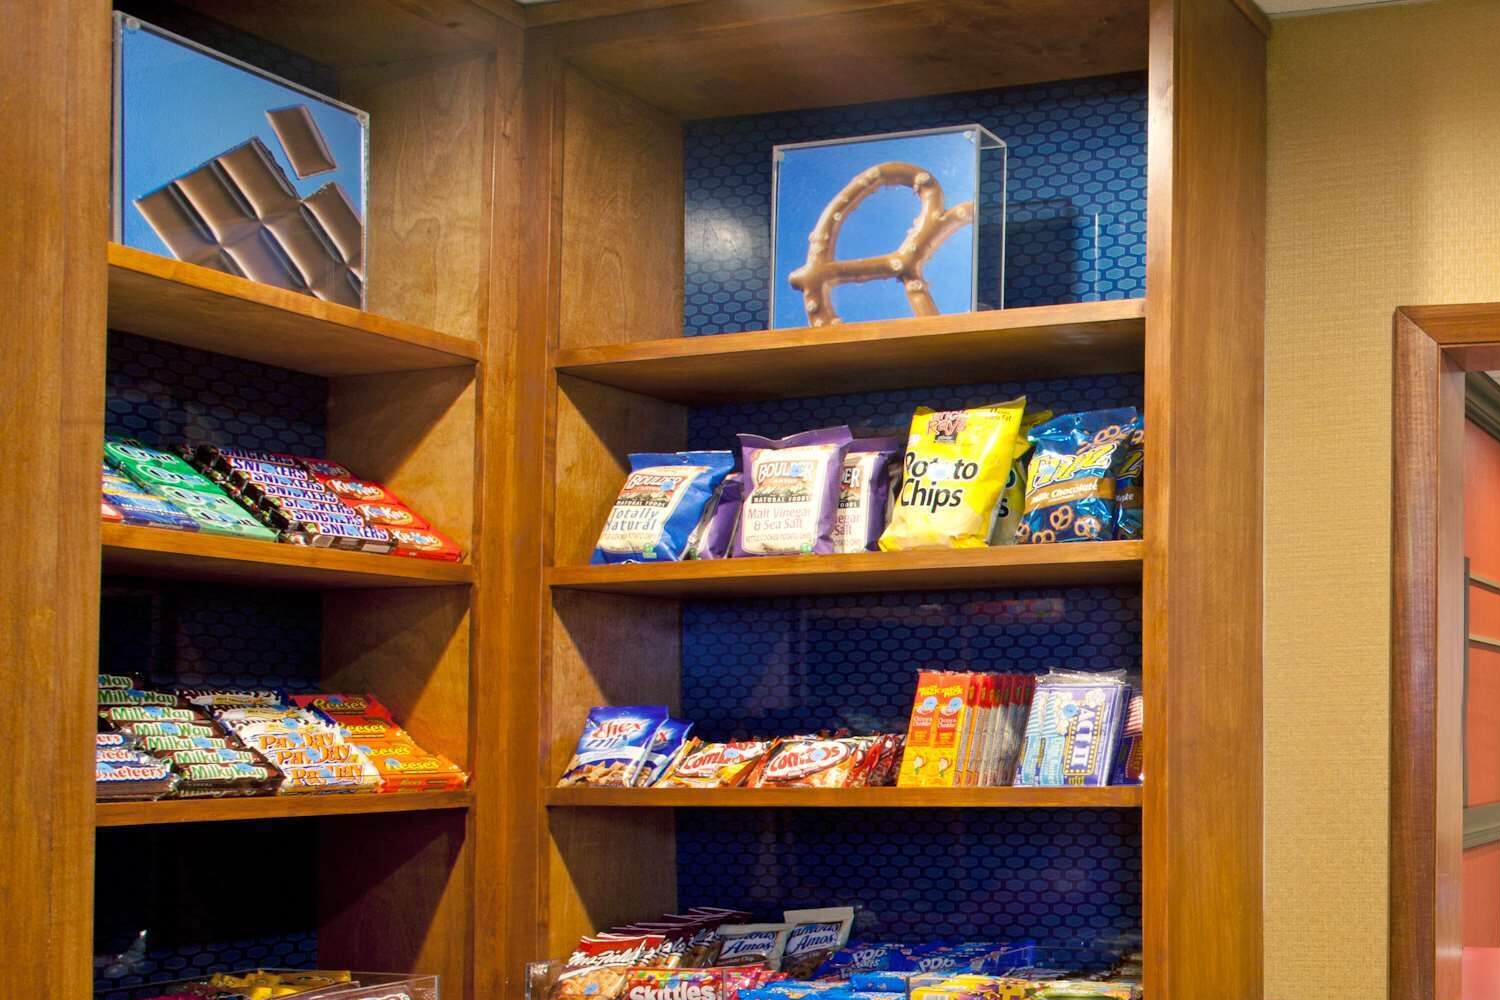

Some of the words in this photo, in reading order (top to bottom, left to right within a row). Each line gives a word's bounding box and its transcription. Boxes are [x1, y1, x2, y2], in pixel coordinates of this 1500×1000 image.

[233, 459, 307, 480] SNIERS
[758, 462, 814, 483] BOULR
[905, 452, 978, 480] Poto
[253, 472, 325, 491] SNIKERS
[625, 474, 685, 491] BOULDR
[267, 487, 338, 503] SNIKERS
[900, 479, 963, 514] Chips
[285, 499, 354, 516] SNKERS
[748, 507, 770, 519] Malt
[774, 506, 810, 521] Vinegar
[322, 522, 387, 541] SNIERS
[764, 518, 782, 530] Sea
[784, 517, 803, 529] Salt
[585, 734, 628, 750] mi
[362, 745, 410, 758] eese's
[723, 938, 772, 955] Amos
[793, 934, 836, 952] Amos
